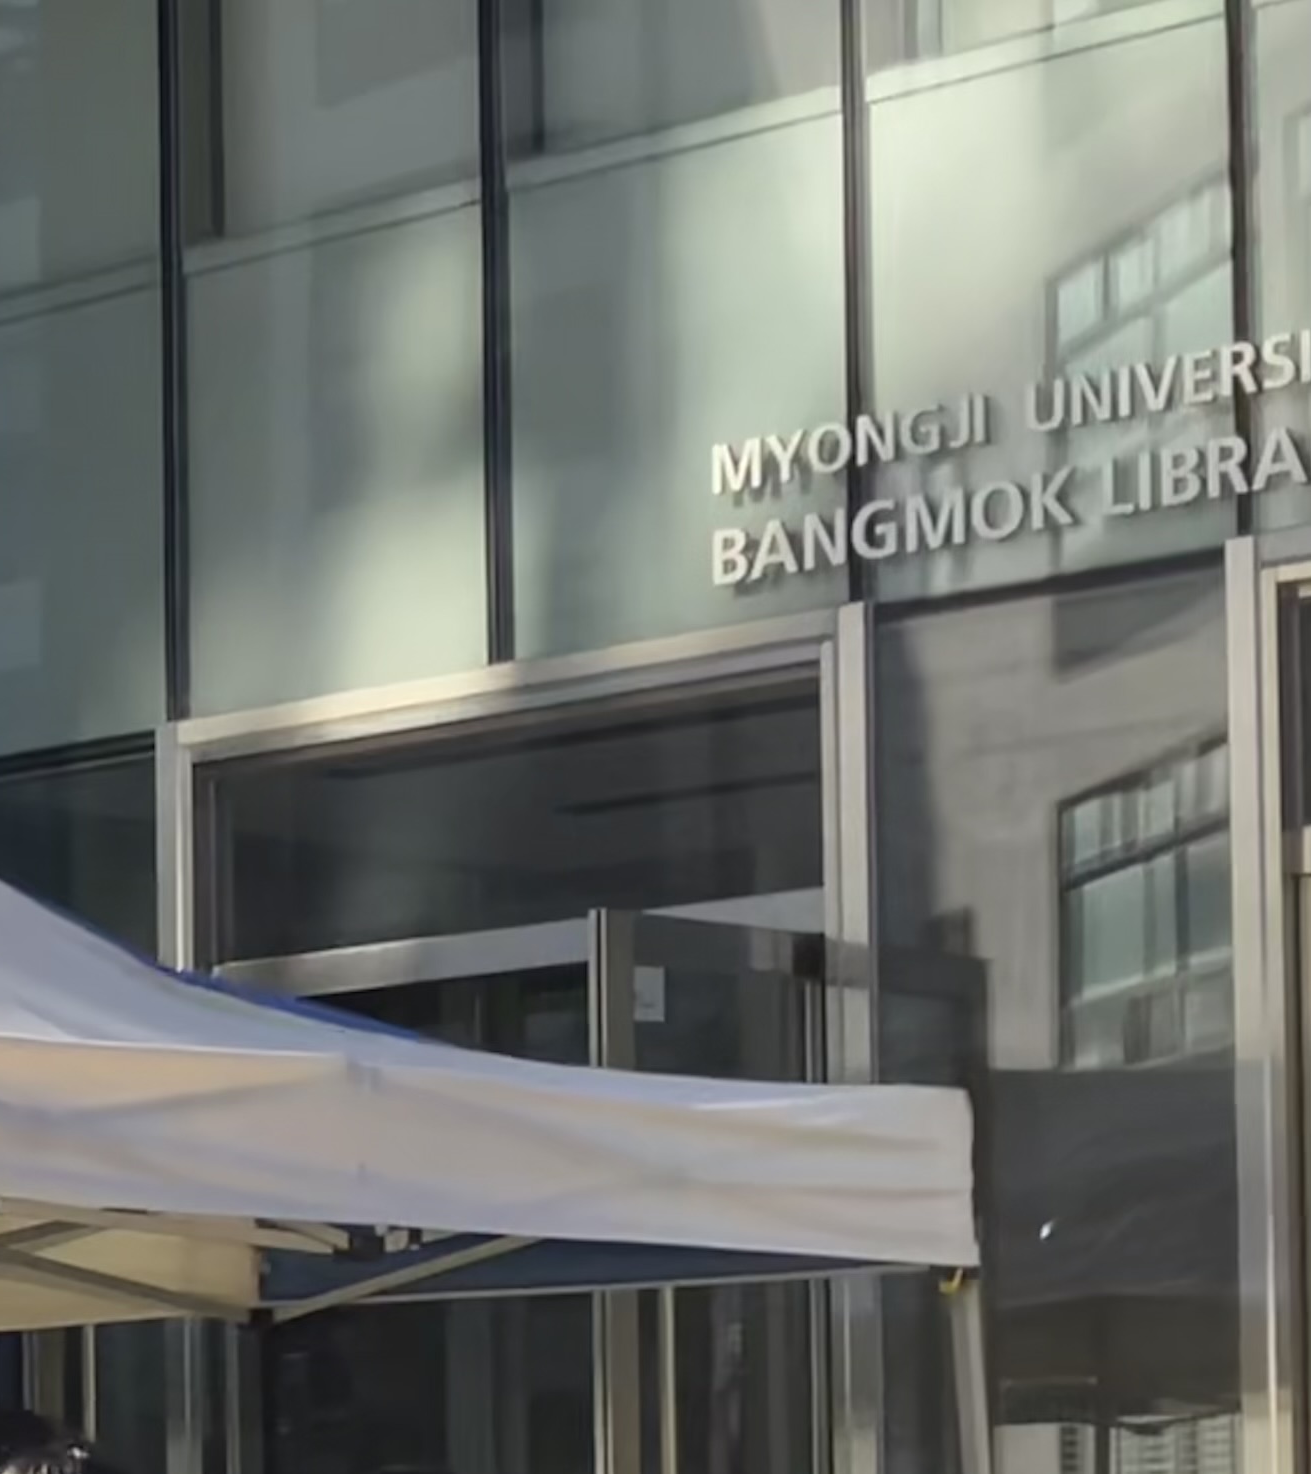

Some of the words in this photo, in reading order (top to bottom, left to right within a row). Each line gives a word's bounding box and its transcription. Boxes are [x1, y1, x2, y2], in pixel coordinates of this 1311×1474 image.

[710, 393, 991, 495] MYONGJI
[1026, 329, 1311, 434] UNIVERSI
[710, 465, 1075, 587] BANGMOK
[1102, 426, 1308, 517] LIBRA
